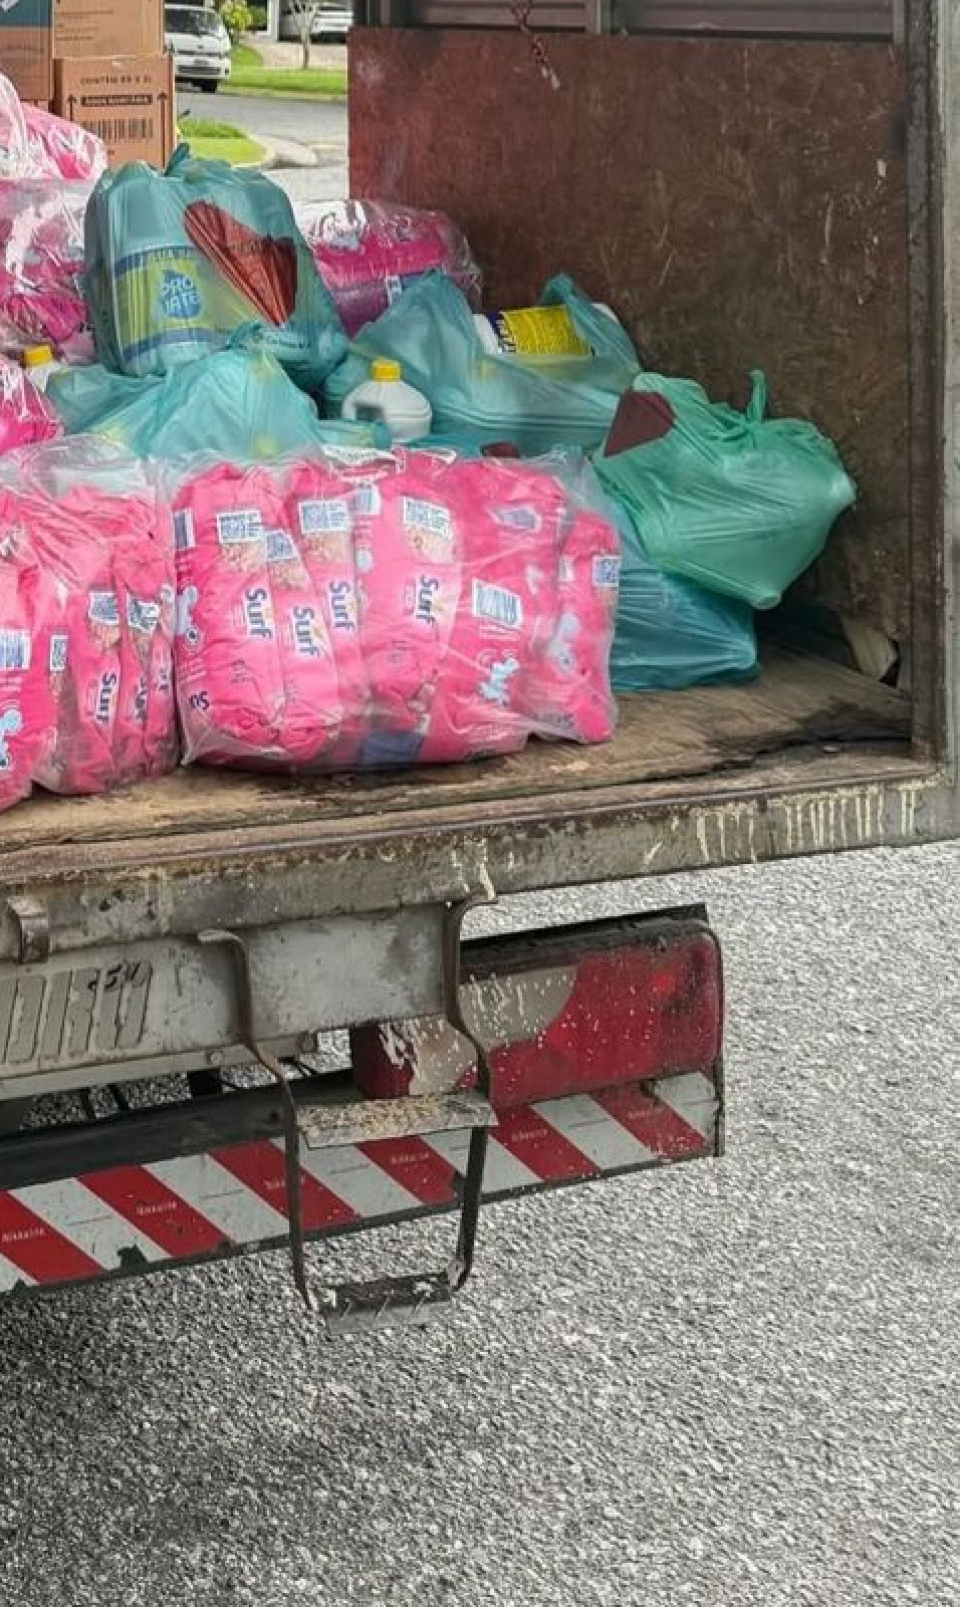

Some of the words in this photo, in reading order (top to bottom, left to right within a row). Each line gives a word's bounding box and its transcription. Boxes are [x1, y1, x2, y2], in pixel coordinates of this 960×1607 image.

[244, 587, 273, 639] Surf
[329, 580, 356, 631] Surf
[415, 574, 439, 626] Surf
[292, 605, 321, 657] Surf
[96, 672, 118, 725] Surf
